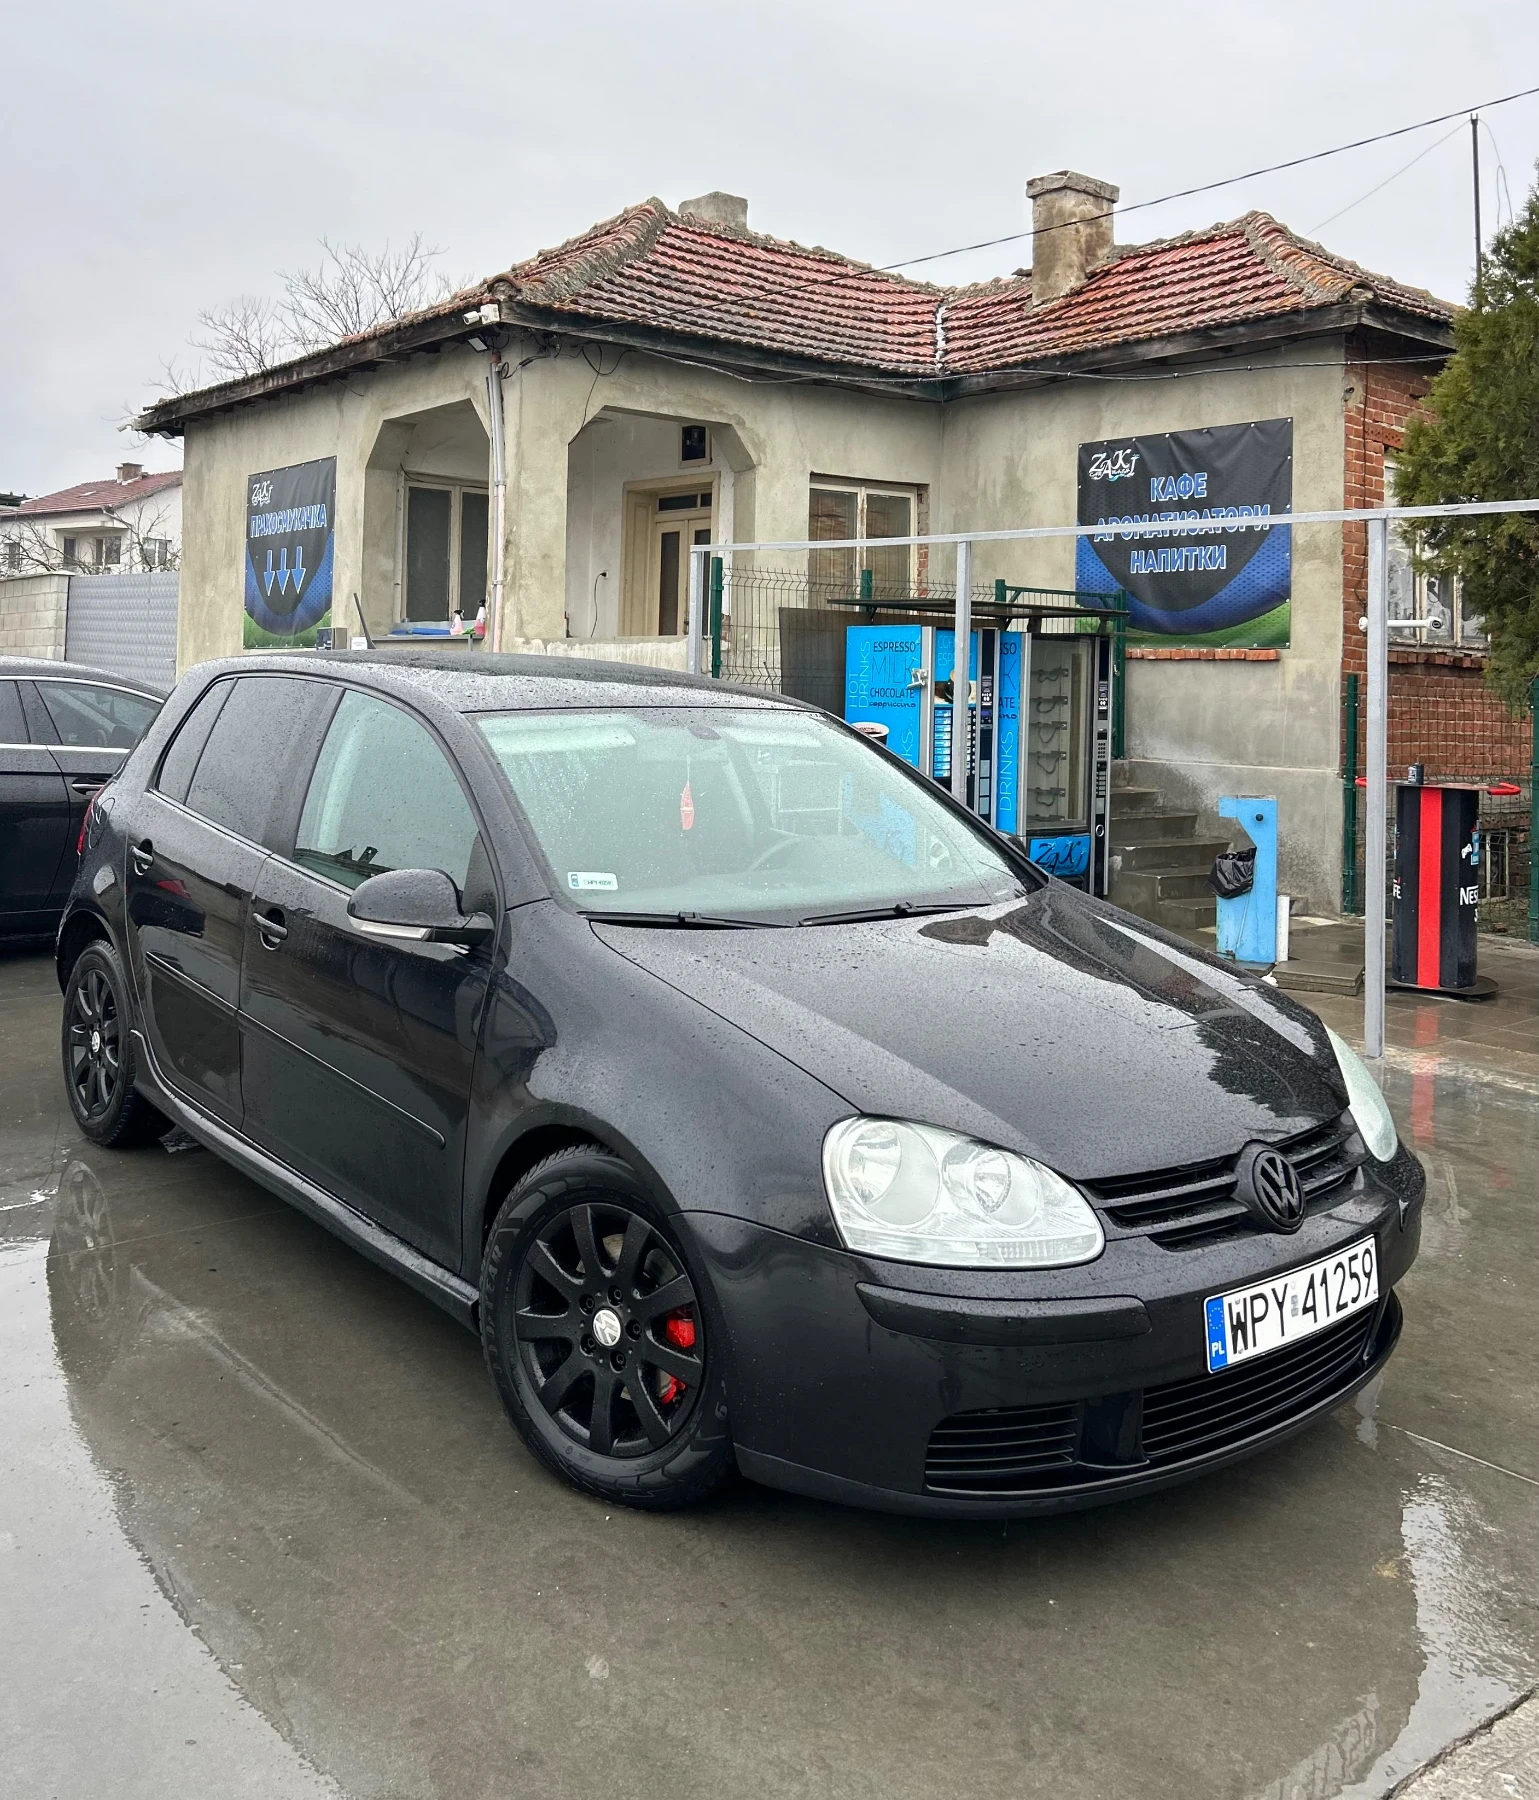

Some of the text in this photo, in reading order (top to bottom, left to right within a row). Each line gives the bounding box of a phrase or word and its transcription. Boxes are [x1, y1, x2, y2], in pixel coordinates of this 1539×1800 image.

[1151, 472, 1207, 502] КАФЕ
[250, 503, 327, 538] ПРАХОСМУКАЧКА
[1130, 545, 1227, 573] НАПИТКИ
[873, 641, 916, 653] ESPRESSO
[858, 640, 871, 708] DRINKS
[869, 687, 915, 699] CHOCOLATE
[999, 731, 1014, 811] DRINKS
[1228, 1247, 1374, 1355] WPY 41259
[1211, 1341, 1225, 1358] PL
